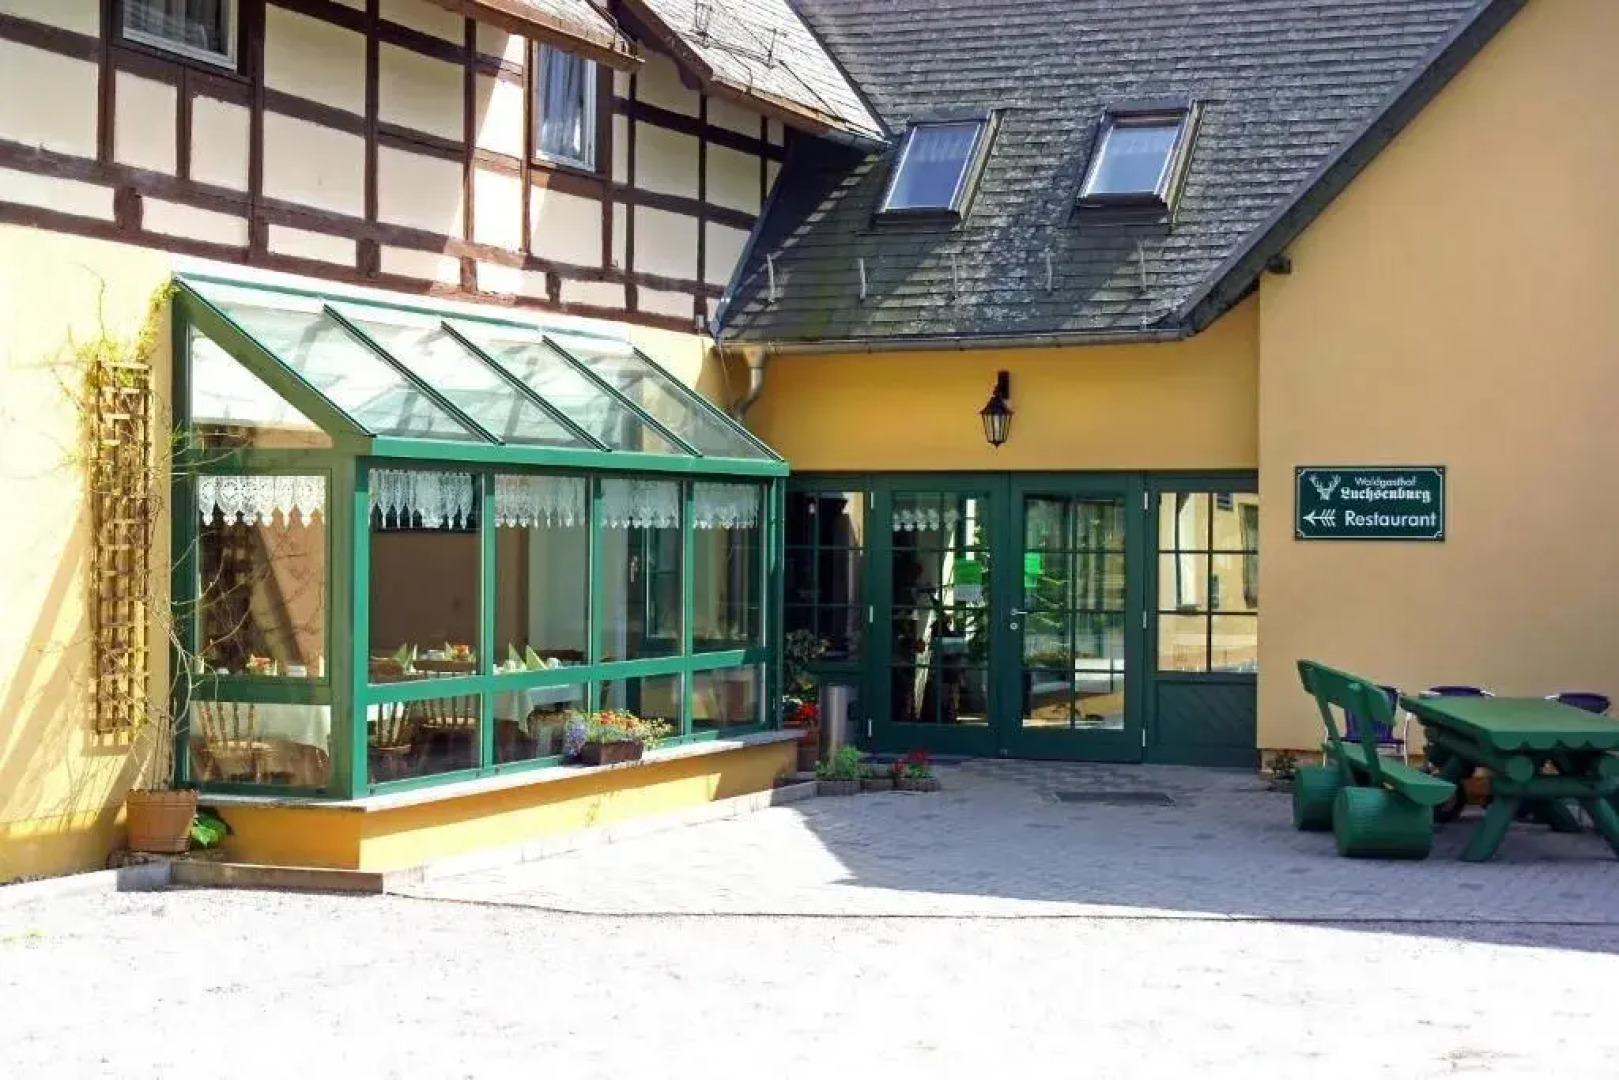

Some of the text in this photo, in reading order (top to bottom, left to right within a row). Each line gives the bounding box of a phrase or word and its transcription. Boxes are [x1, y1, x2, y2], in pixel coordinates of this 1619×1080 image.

[1354, 475, 1417, 489] Waldgasthof
[1340, 487, 1431, 503] Luchsenburg
[1345, 510, 1437, 527] Restaurant
